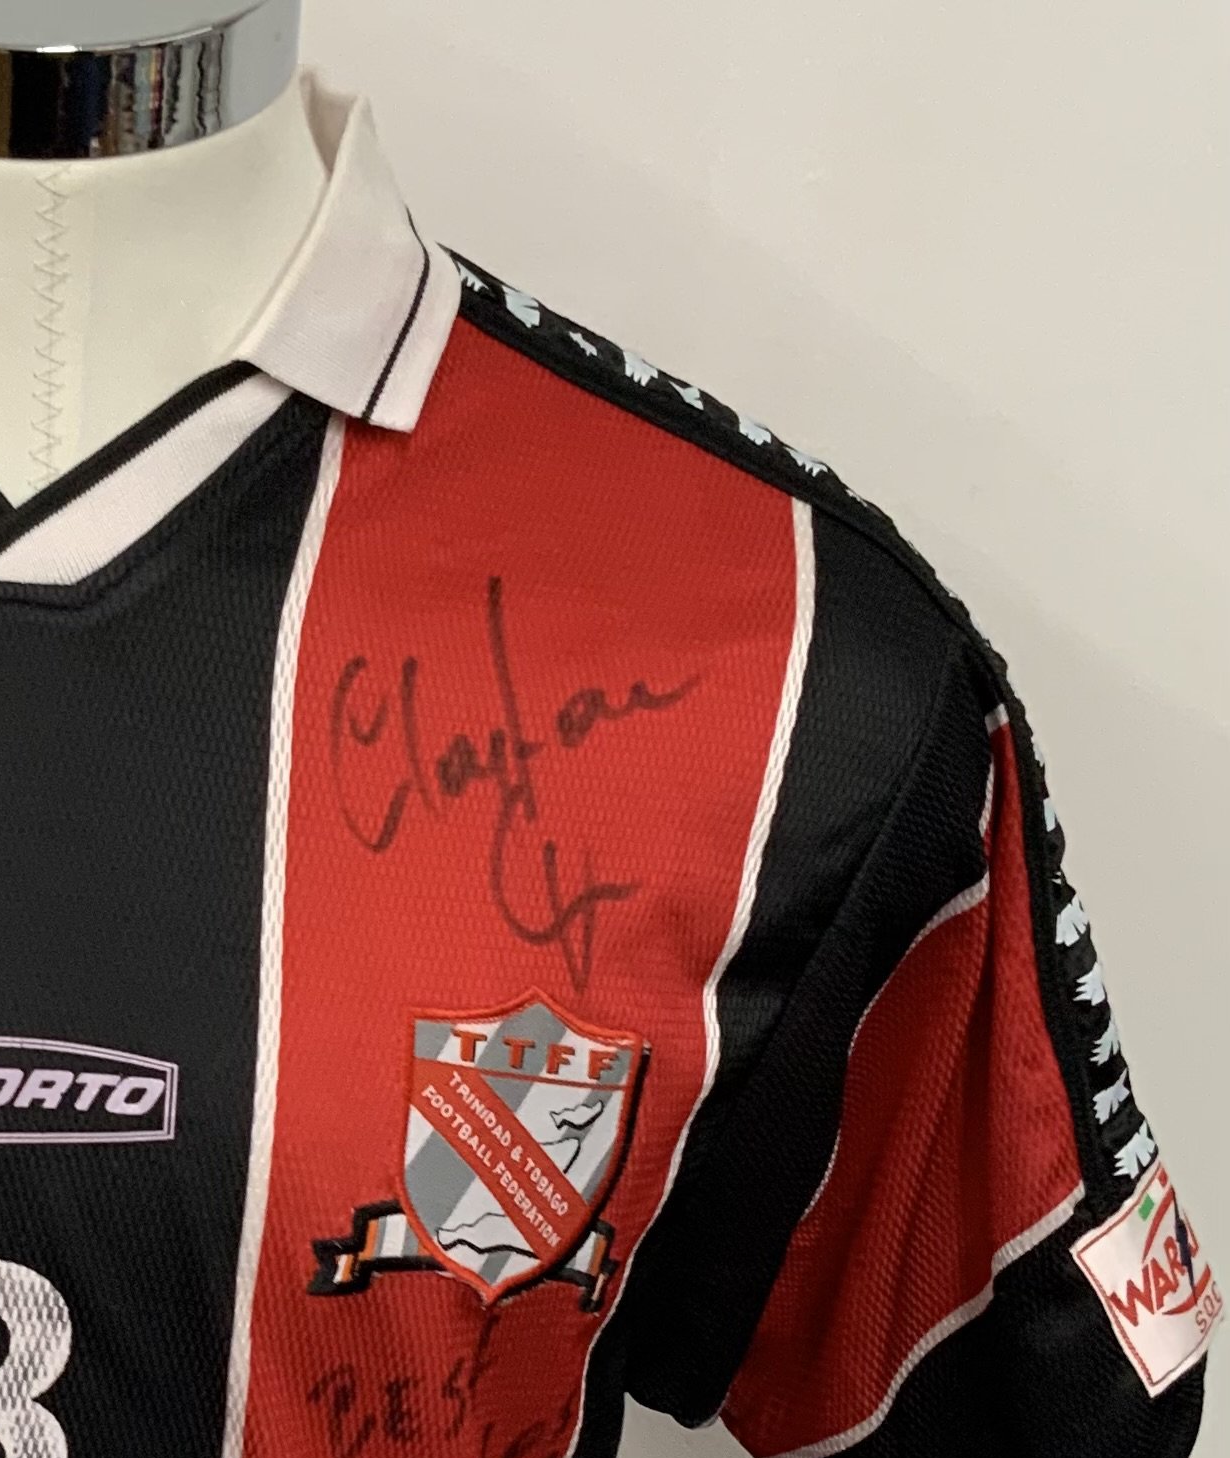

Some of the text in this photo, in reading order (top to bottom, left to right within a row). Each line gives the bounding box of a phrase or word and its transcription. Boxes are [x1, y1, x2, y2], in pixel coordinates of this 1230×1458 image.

[421, 1084, 563, 1248] FOOTBALL FEDERATION
[448, 1070, 569, 1217] TRINIDAD & TOBAGO
